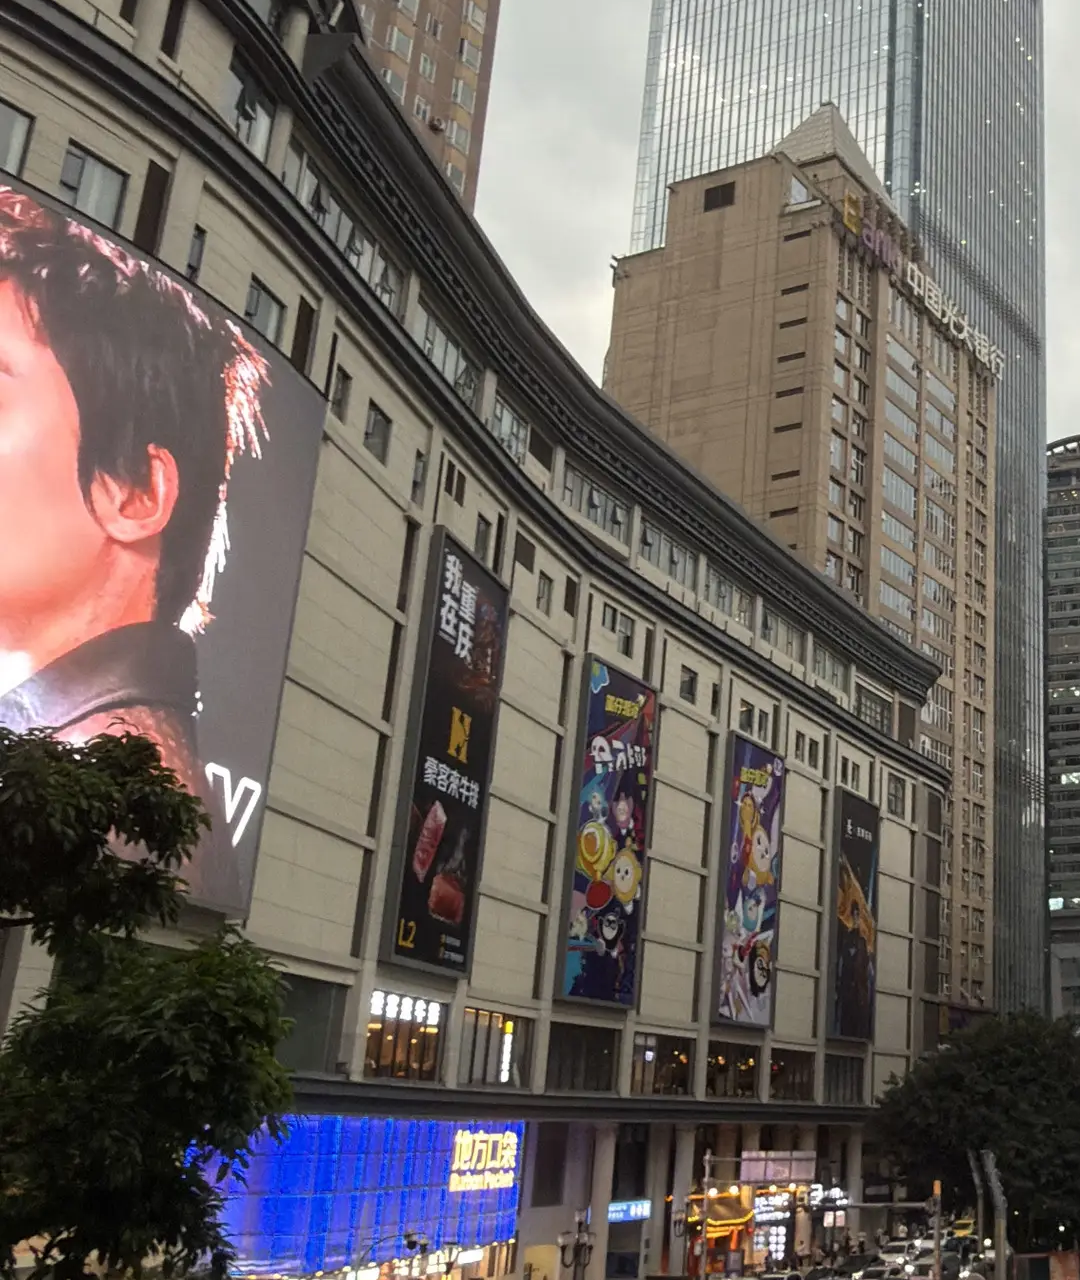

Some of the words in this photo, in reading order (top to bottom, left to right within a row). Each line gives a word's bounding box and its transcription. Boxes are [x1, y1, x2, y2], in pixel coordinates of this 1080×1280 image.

[907, 261, 1004, 380] 中国光大银行
[452, 1129, 518, 1171] 地方口袋
